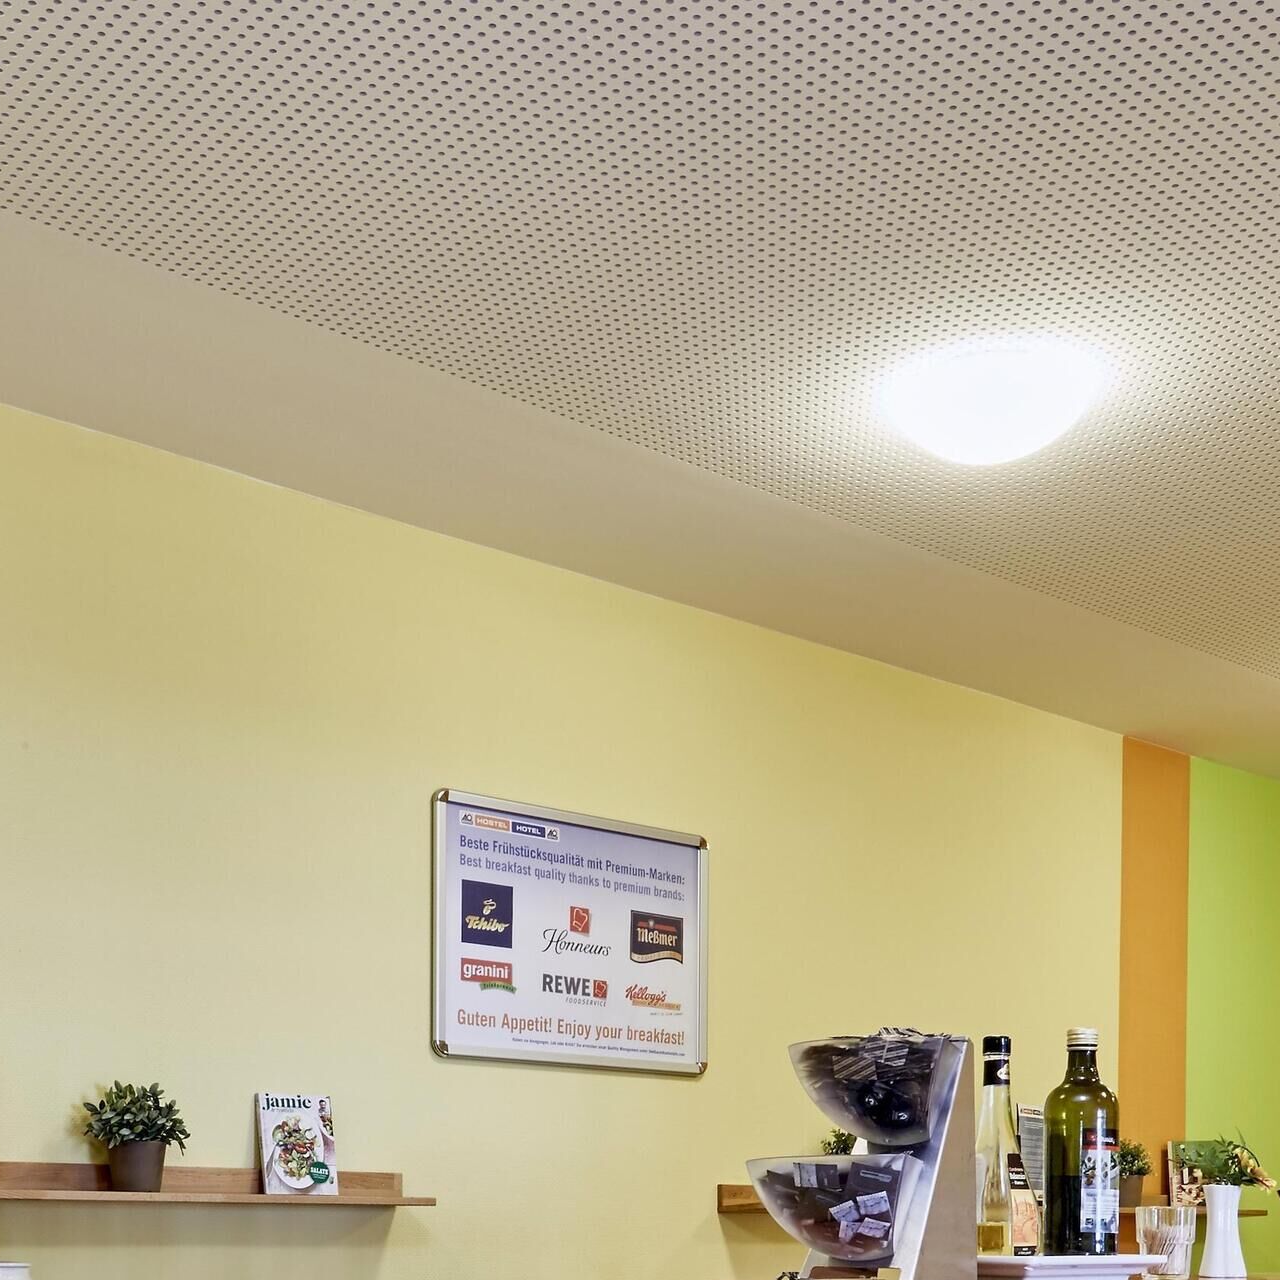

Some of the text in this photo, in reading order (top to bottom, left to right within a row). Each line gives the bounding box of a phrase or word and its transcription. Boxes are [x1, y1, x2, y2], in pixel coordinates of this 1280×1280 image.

[476, 817, 508, 829] HOSTEL
[516, 825, 541, 835] HOTEL
[460, 835, 685, 885] Beste Frühstücksqualität mit Premium-Marken:
[460, 854, 685, 902] Best breakfast quality thanks to premium brands:
[465, 915, 509, 933] Tchibo
[542, 928, 611, 956] Honneurs
[637, 927, 678, 947] Meßmer
[463, 962, 509, 980] granini
[542, 973, 590, 997] REWE
[625, 984, 667, 1006] Kellogg's
[566, 997, 607, 1008] FOODSERVICE
[457, 1008, 685, 1046] Guten Appetit! Enjoy your breakfast!
